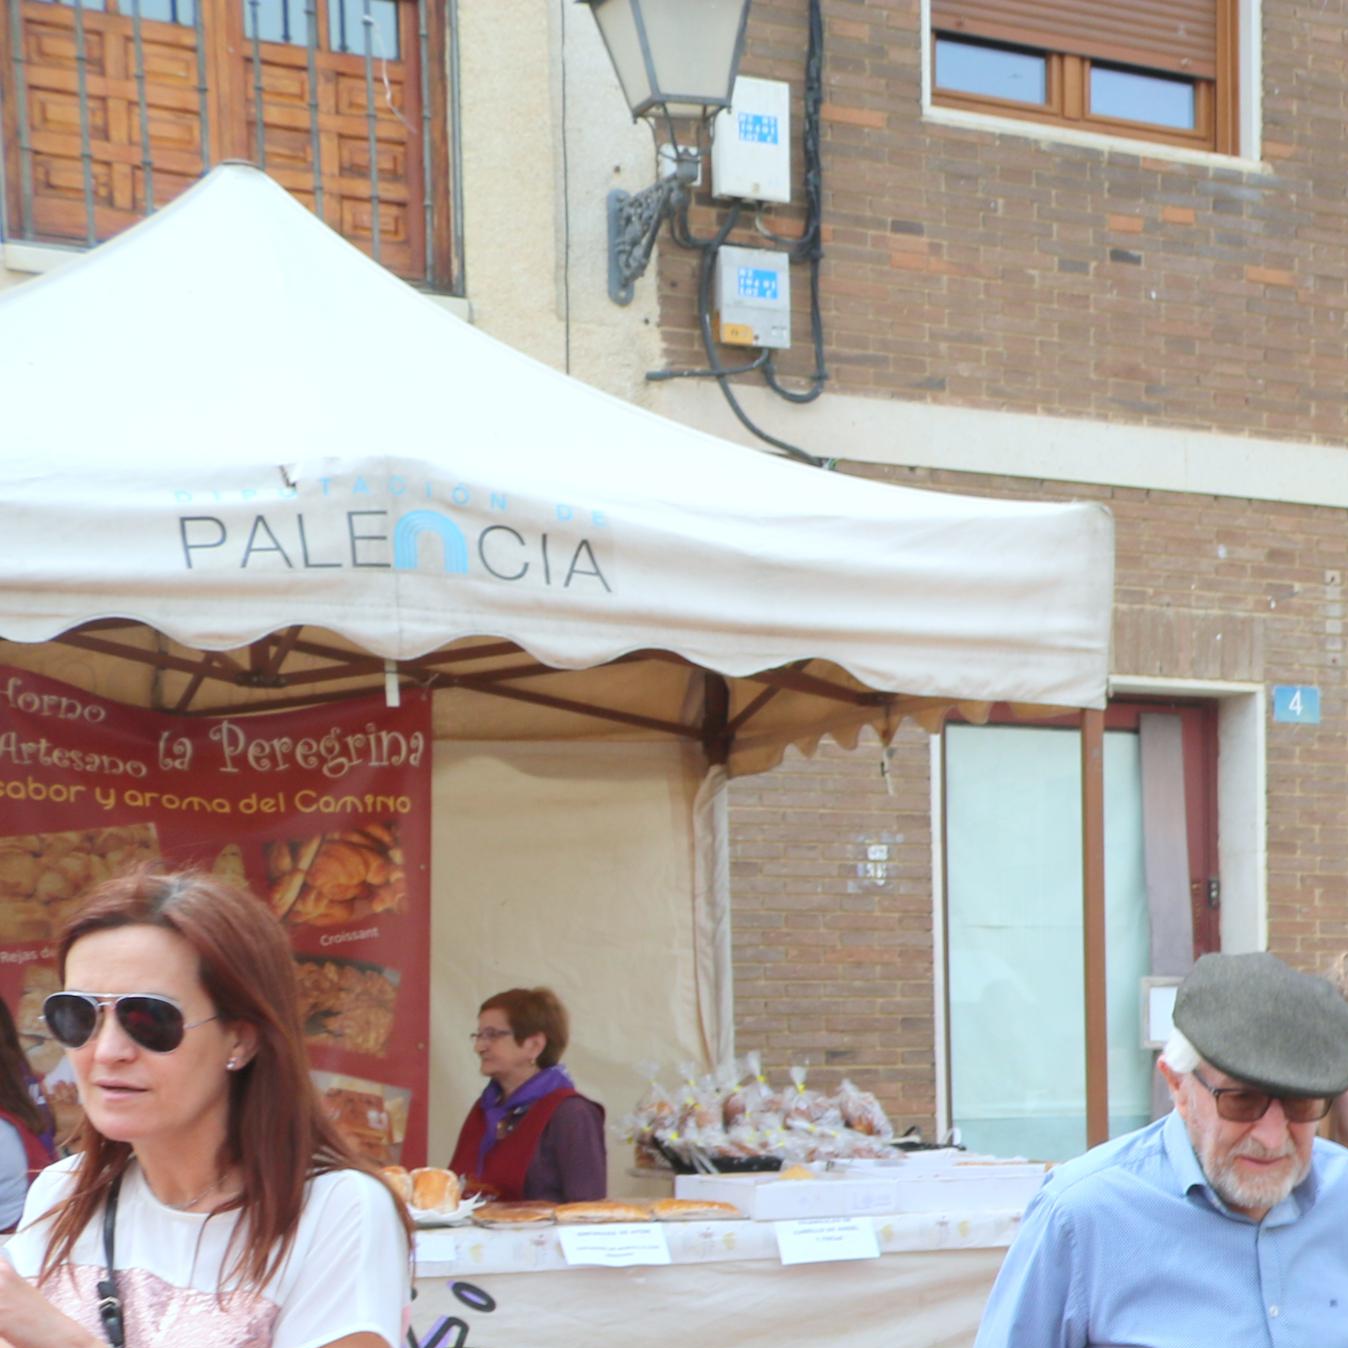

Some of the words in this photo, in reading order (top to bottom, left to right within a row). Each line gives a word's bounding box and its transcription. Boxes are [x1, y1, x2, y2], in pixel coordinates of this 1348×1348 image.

[1288, 689, 1303, 716] 4
[0, 731, 147, 777] Artesano
[208, 719, 425, 778] Peregrina
[94, 786, 116, 810] y
[123, 788, 231, 814] aroma
[239, 791, 286, 815] del
[294, 789, 411, 814] Camino
[320, 926, 380, 946] Croissant
